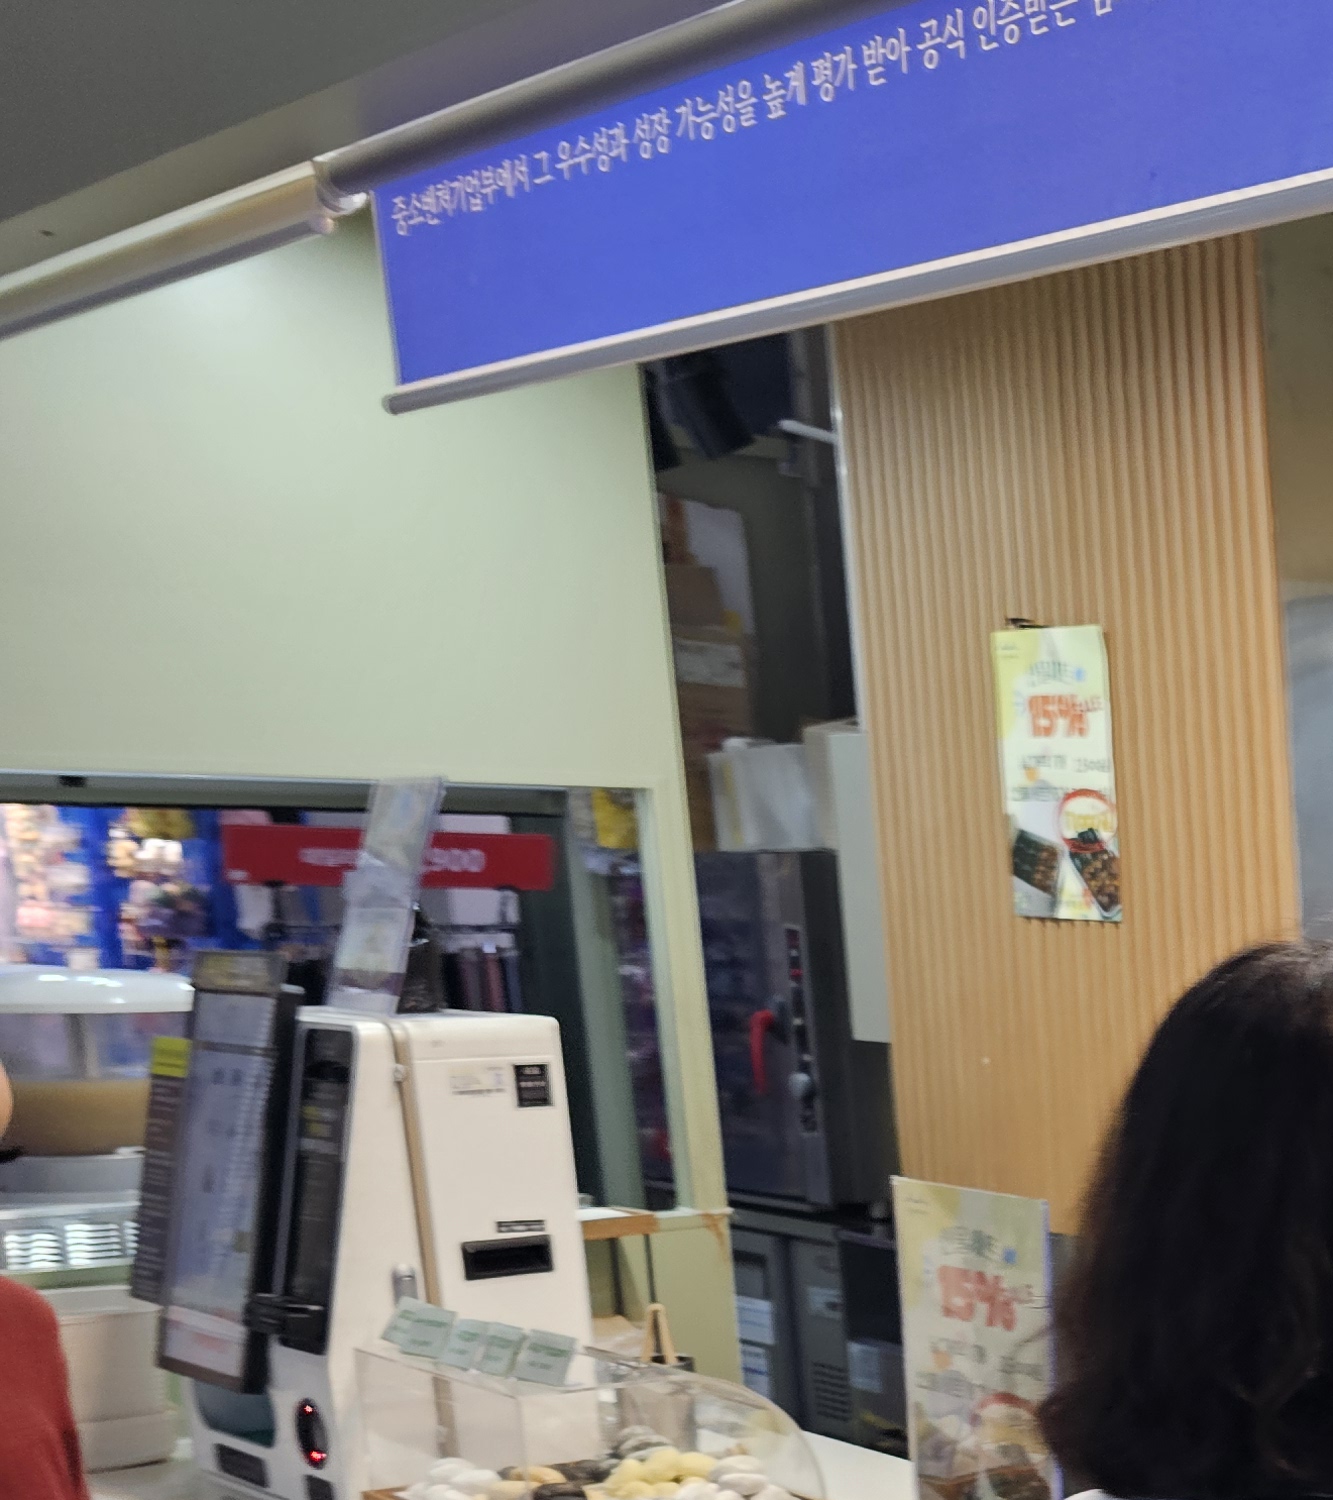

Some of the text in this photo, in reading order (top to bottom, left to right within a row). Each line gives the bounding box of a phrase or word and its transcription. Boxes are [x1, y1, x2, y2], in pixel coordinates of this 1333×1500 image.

[391, 154, 530, 236] 중소벤처기업부에서
[532, 150, 556, 185] 그
[554, 121, 630, 179] 우수성과
[633, 107, 672, 159] 성장
[675, 80, 758, 141] 가능성을
[762, 60, 808, 120] 높게
[811, 46, 857, 102] 평가
[862, 28, 912, 87] 받아
[916, 8, 967, 70] 공식
